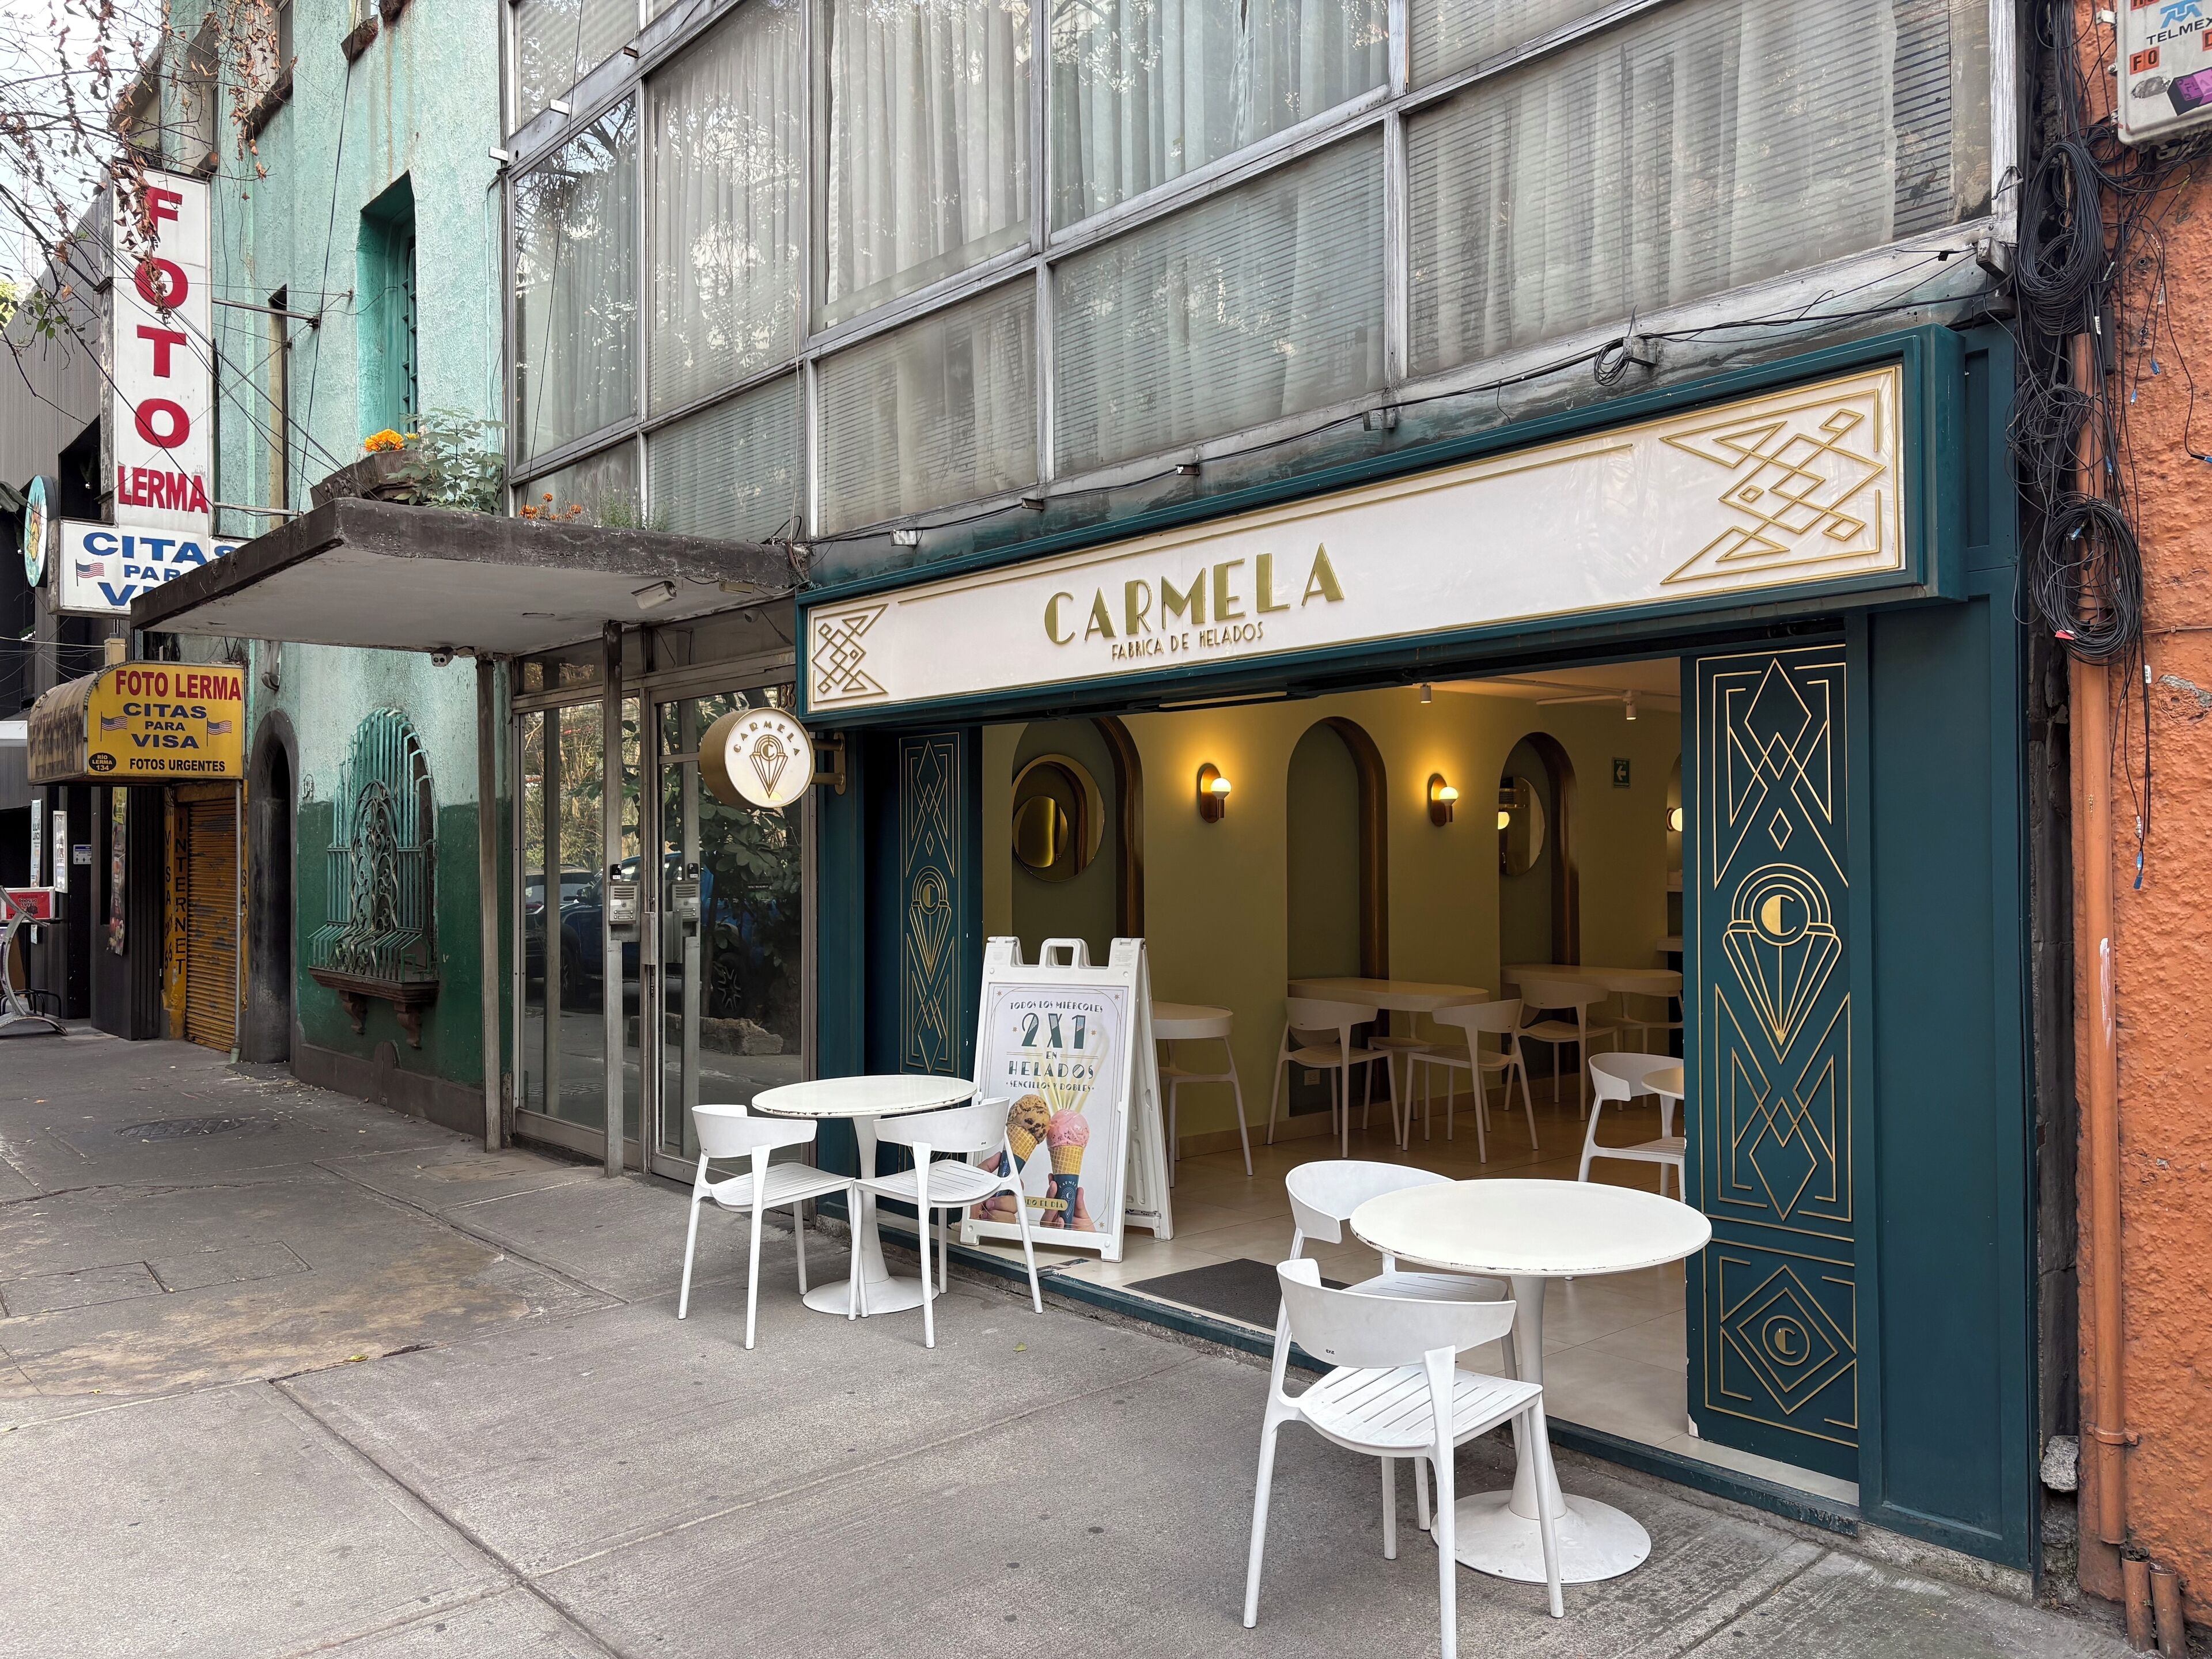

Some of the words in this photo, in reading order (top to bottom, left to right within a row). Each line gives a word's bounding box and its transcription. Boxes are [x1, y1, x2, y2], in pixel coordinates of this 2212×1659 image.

[2146, 17, 2212, 45] TELMEX
[134, 186, 190, 448] FOTO
[118, 465, 208, 514] LERMA
[124, 565, 180, 581] PAR
[1044, 542, 1344, 645] CARMELA
[1112, 637, 1164, 661] FABRICA
[1171, 632, 1189, 652] DE
[1199, 621, 1263, 648] HELADOS
[116, 670, 168, 697] FOTO
[175, 673, 241, 700] LERMA
[777, 683, 796, 708] 136
[123, 703, 207, 719] CITAS
[145, 721, 185, 731] PARA
[733, 721, 800, 756] CARMELA
[131, 733, 199, 749] VISA
[762, 744, 775, 757] C
[130, 758, 165, 770] FOTOS
[169, 760, 225, 772] URGENTES
[175, 817, 187, 975] INTERNET
[1761, 894, 1797, 936] C
[1010, 1001, 1036, 1009] TODOS
[1056, 999, 1103, 1013] MIÉRCOLES
[1021, 1012, 1086, 1050] 2X1
[1046, 1051, 1057, 1059] EN
[1009, 1060, 1094, 1079] HELADOS
[1010, 1080, 1050, 1089] SENCILLOS
[1060, 1083, 1091, 1092] DOBLES
[1774, 1327, 1797, 1355] C
